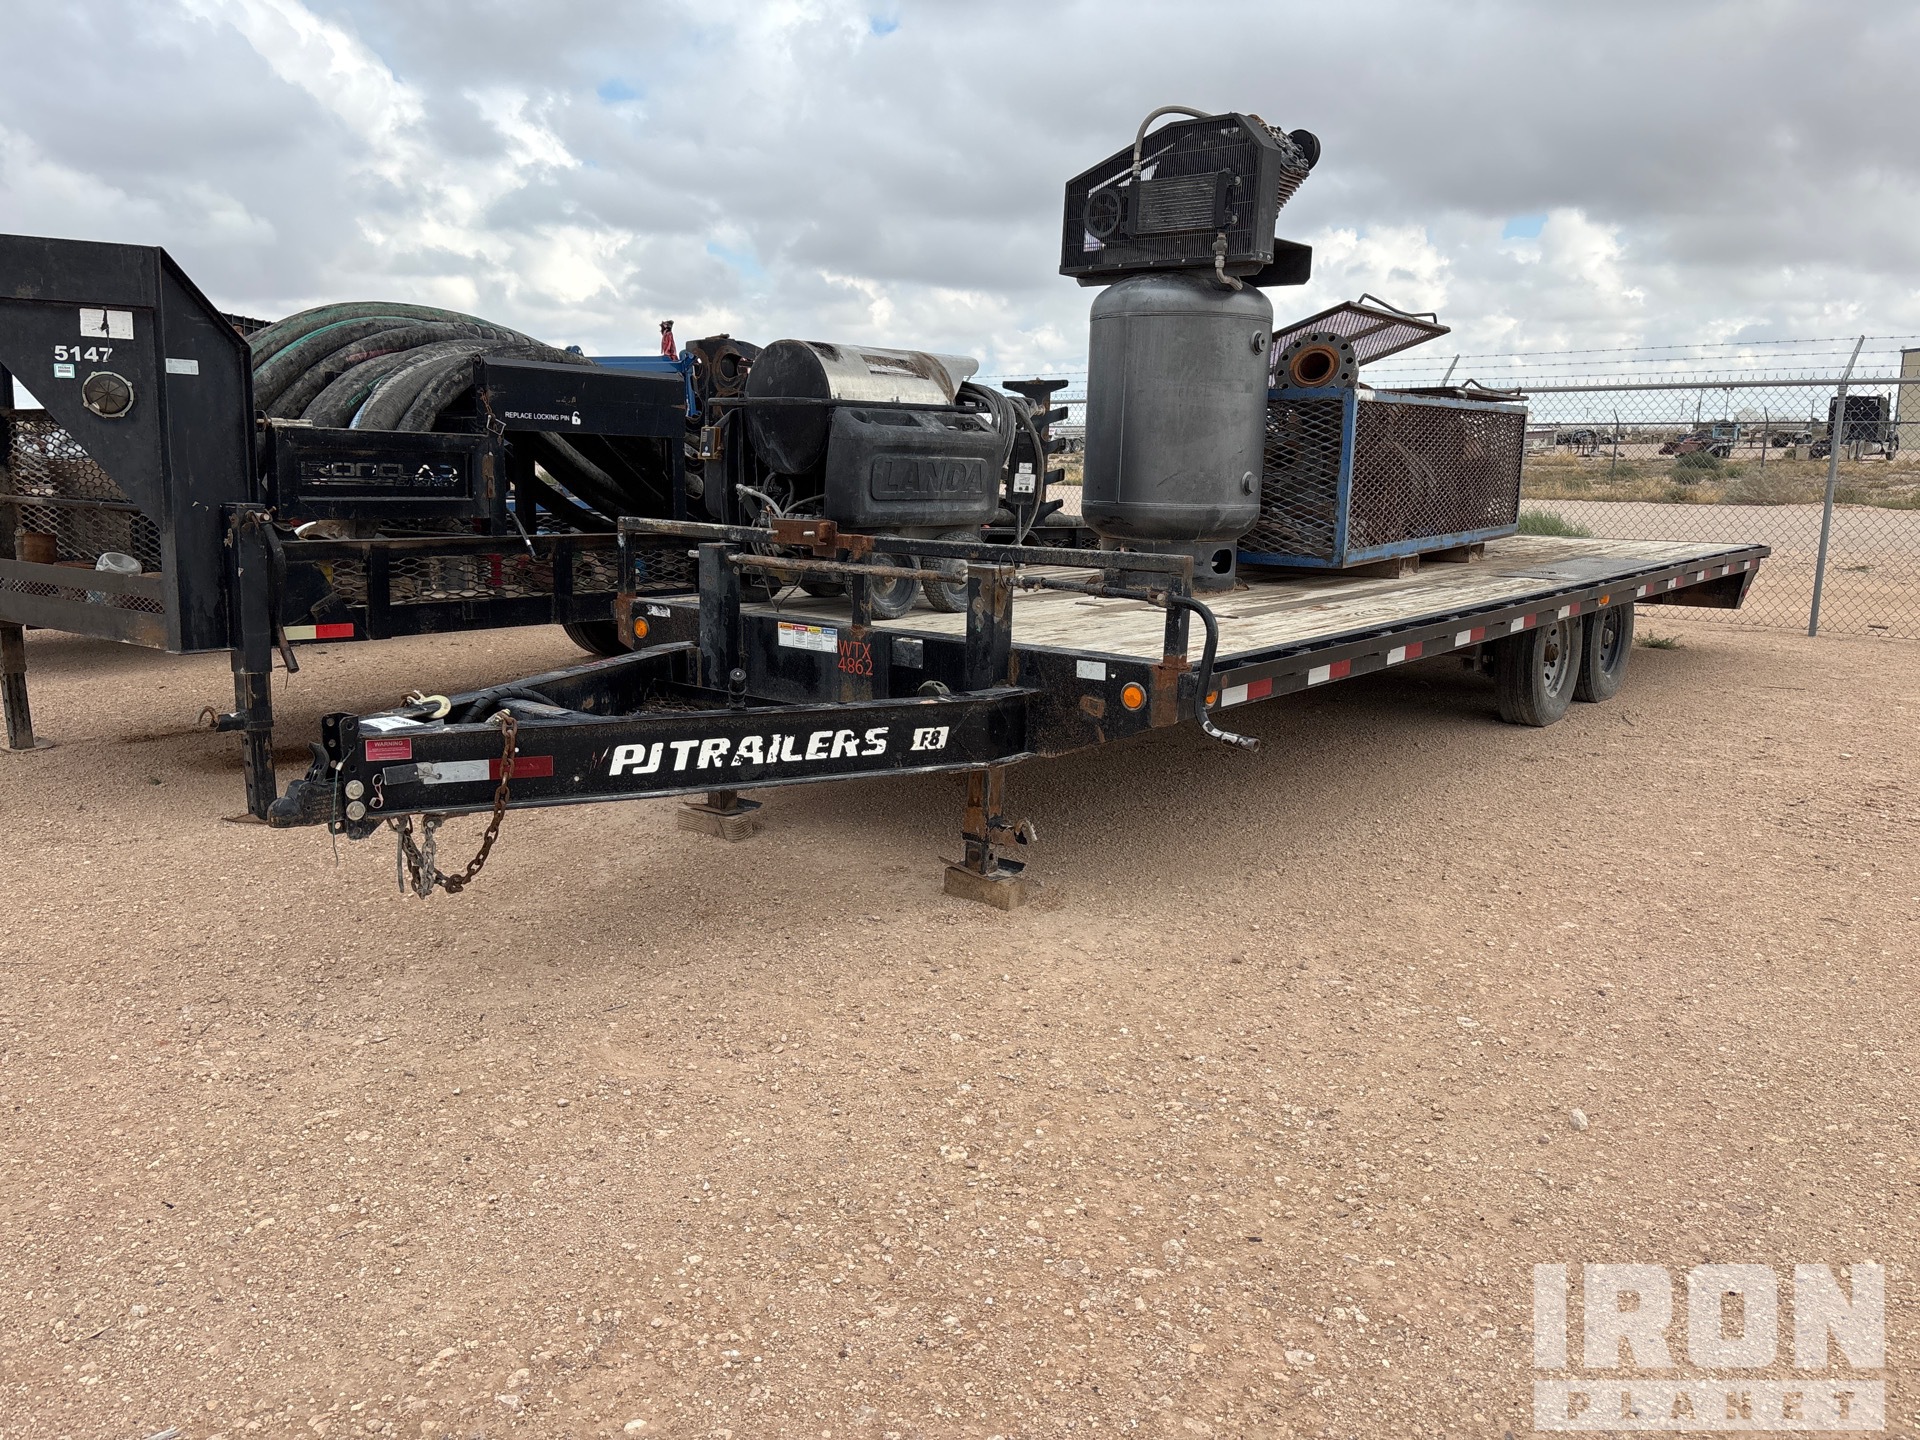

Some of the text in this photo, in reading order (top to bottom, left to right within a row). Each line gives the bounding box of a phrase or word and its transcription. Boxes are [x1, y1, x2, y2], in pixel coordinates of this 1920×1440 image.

[54, 345, 113, 362] 5147
[505, 411, 532, 420] REPLACE
[533, 413, 559, 421] LOCKING
[879, 461, 983, 493] LANDA
[838, 640, 871, 659] WTX
[837, 657, 873, 676] 4862
[670, 727, 889, 771] TRAILERS
